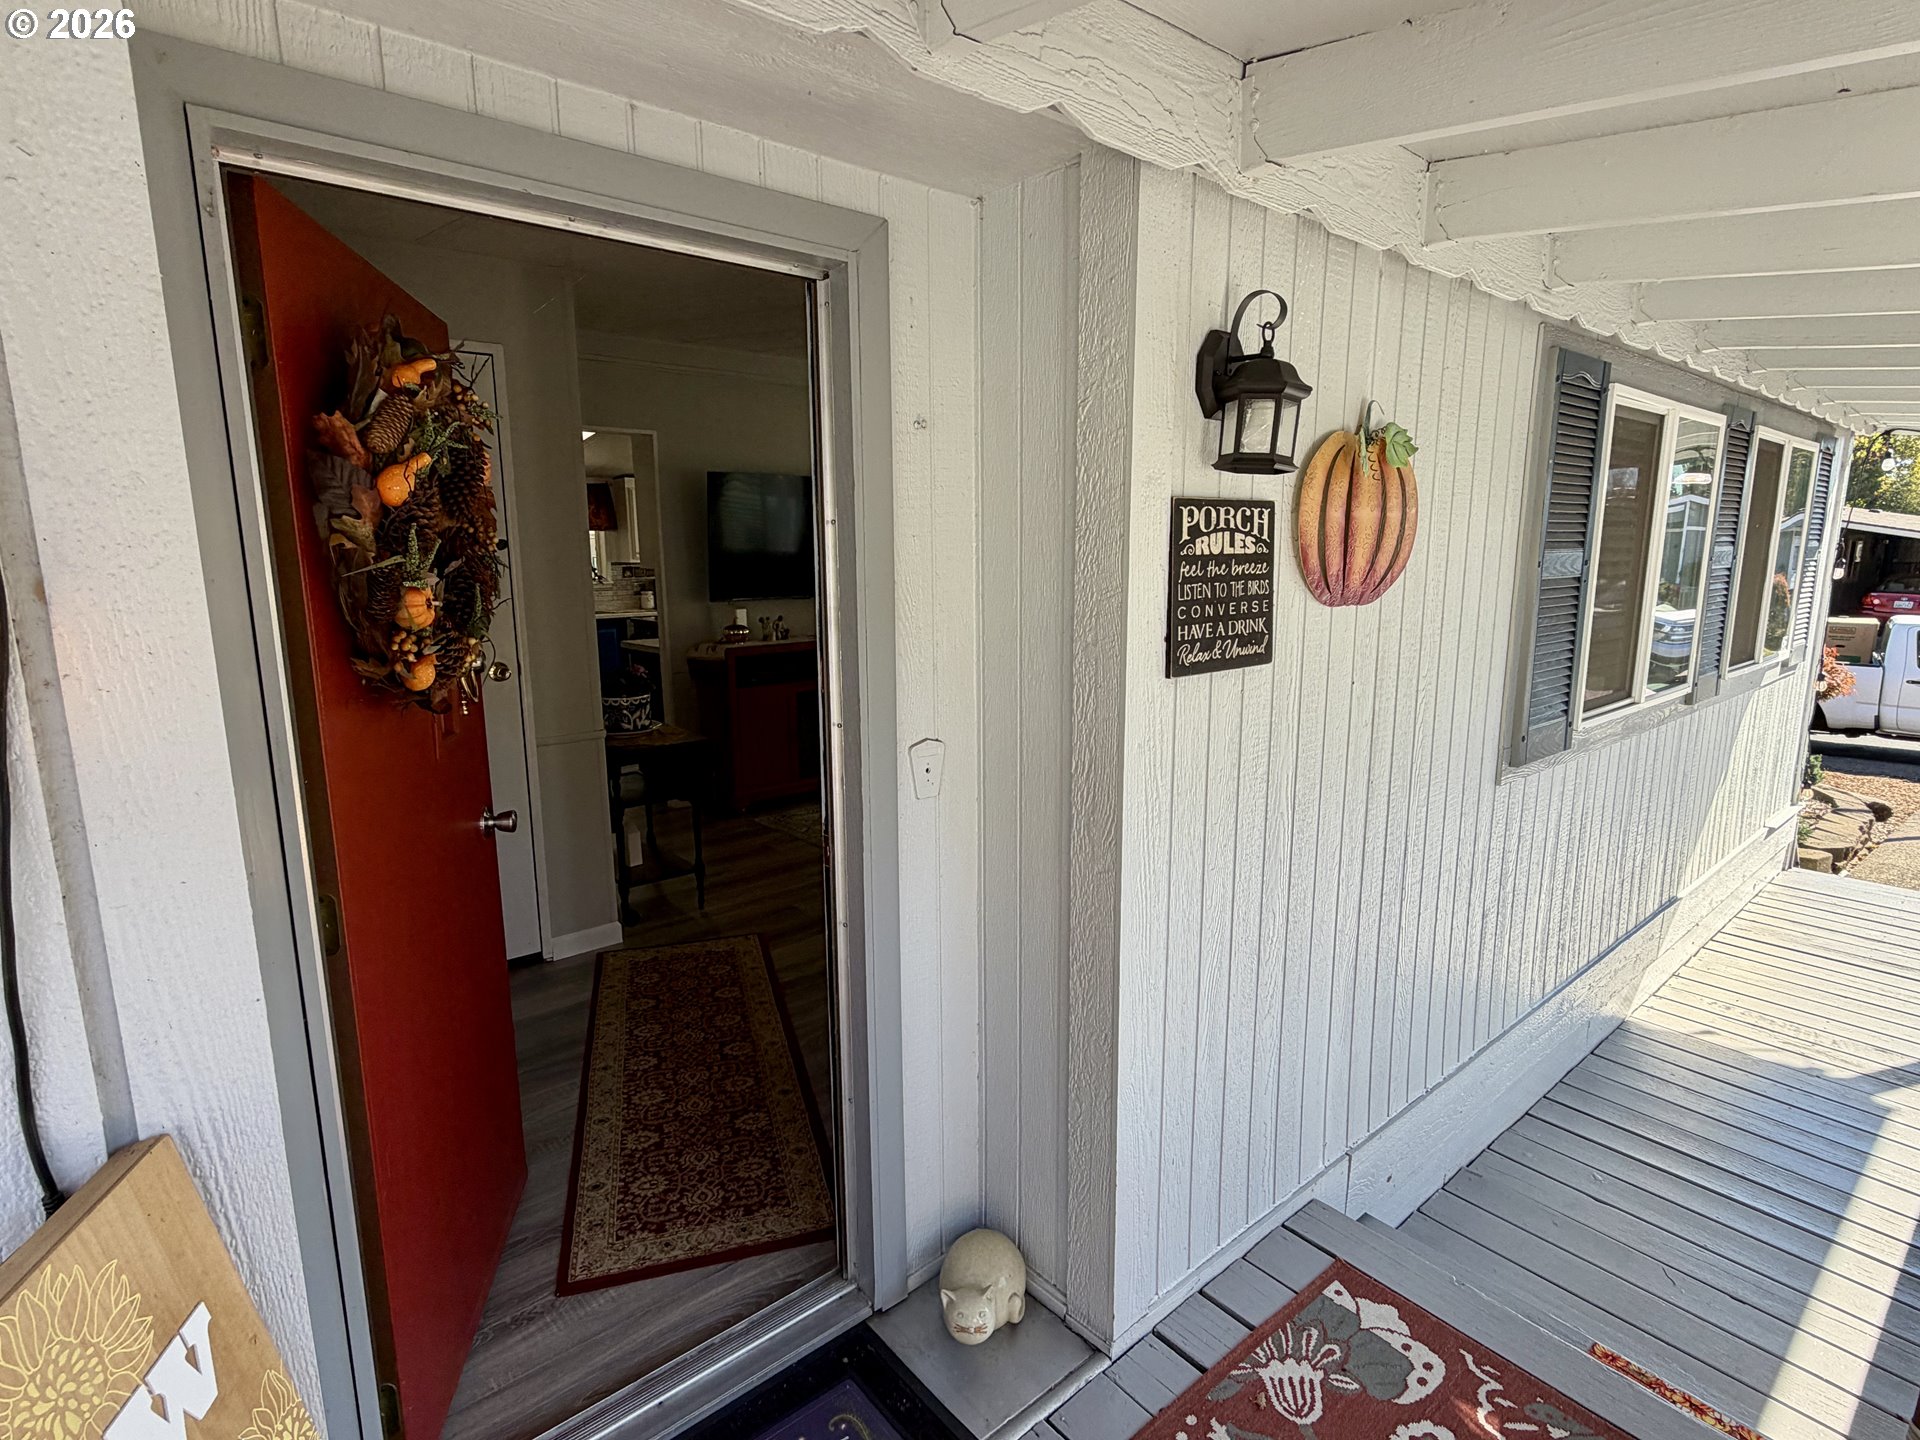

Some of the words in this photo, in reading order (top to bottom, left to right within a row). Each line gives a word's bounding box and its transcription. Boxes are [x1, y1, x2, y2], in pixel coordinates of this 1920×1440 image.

[1179, 506, 1271, 544] PORCH
[1195, 531, 1256, 555] RULES
[1178, 560, 1204, 582] feel
[1207, 560, 1228, 577] the
[1231, 559, 1269, 576] breeze
[1178, 582, 1211, 601] LISTEN
[1214, 582, 1227, 598] TO
[1230, 581, 1245, 598] THE
[1247, 579, 1269, 596] BIRDS
[1177, 600, 1269, 619] CONVERSE
[1178, 622, 1213, 641] HAVE
[1216, 622, 1225, 637] A
[1228, 617, 1268, 636] DRINK
[1177, 643, 1212, 666] Relax
[1212, 640, 1223, 659] &
[1222, 635, 1269, 659] Unwind
